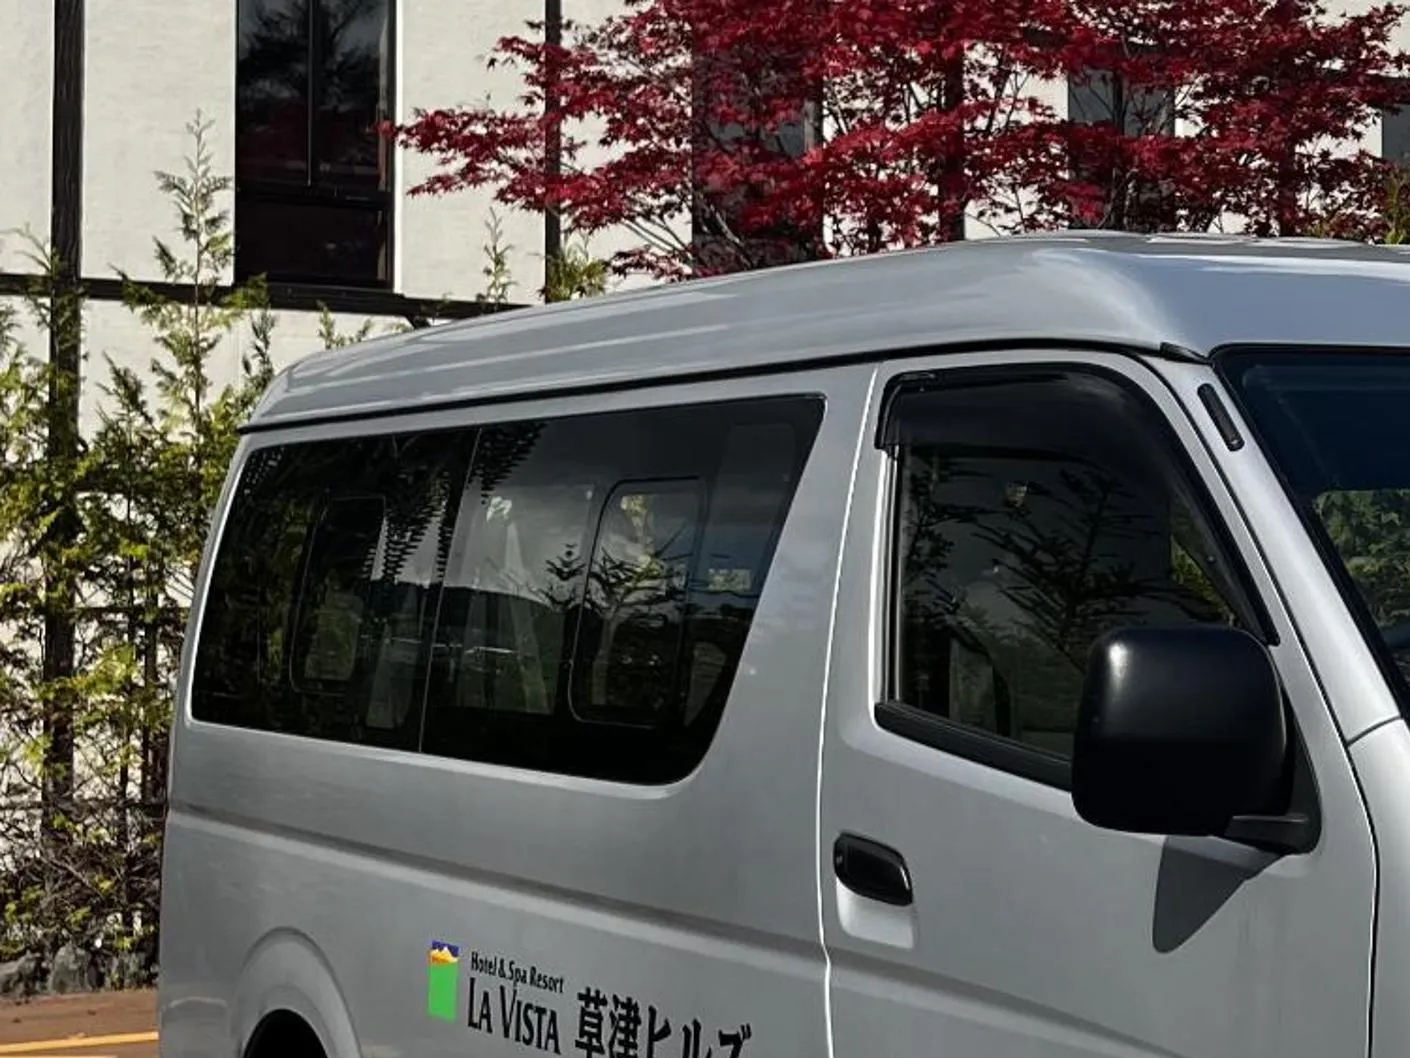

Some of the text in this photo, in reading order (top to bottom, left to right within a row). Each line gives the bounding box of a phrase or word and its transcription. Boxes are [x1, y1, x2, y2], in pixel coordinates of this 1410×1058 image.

[471, 951, 564, 993] Hotel & Spa Resort
[468, 977, 493, 1034] LA
[500, 985, 561, 1055] VISTA
